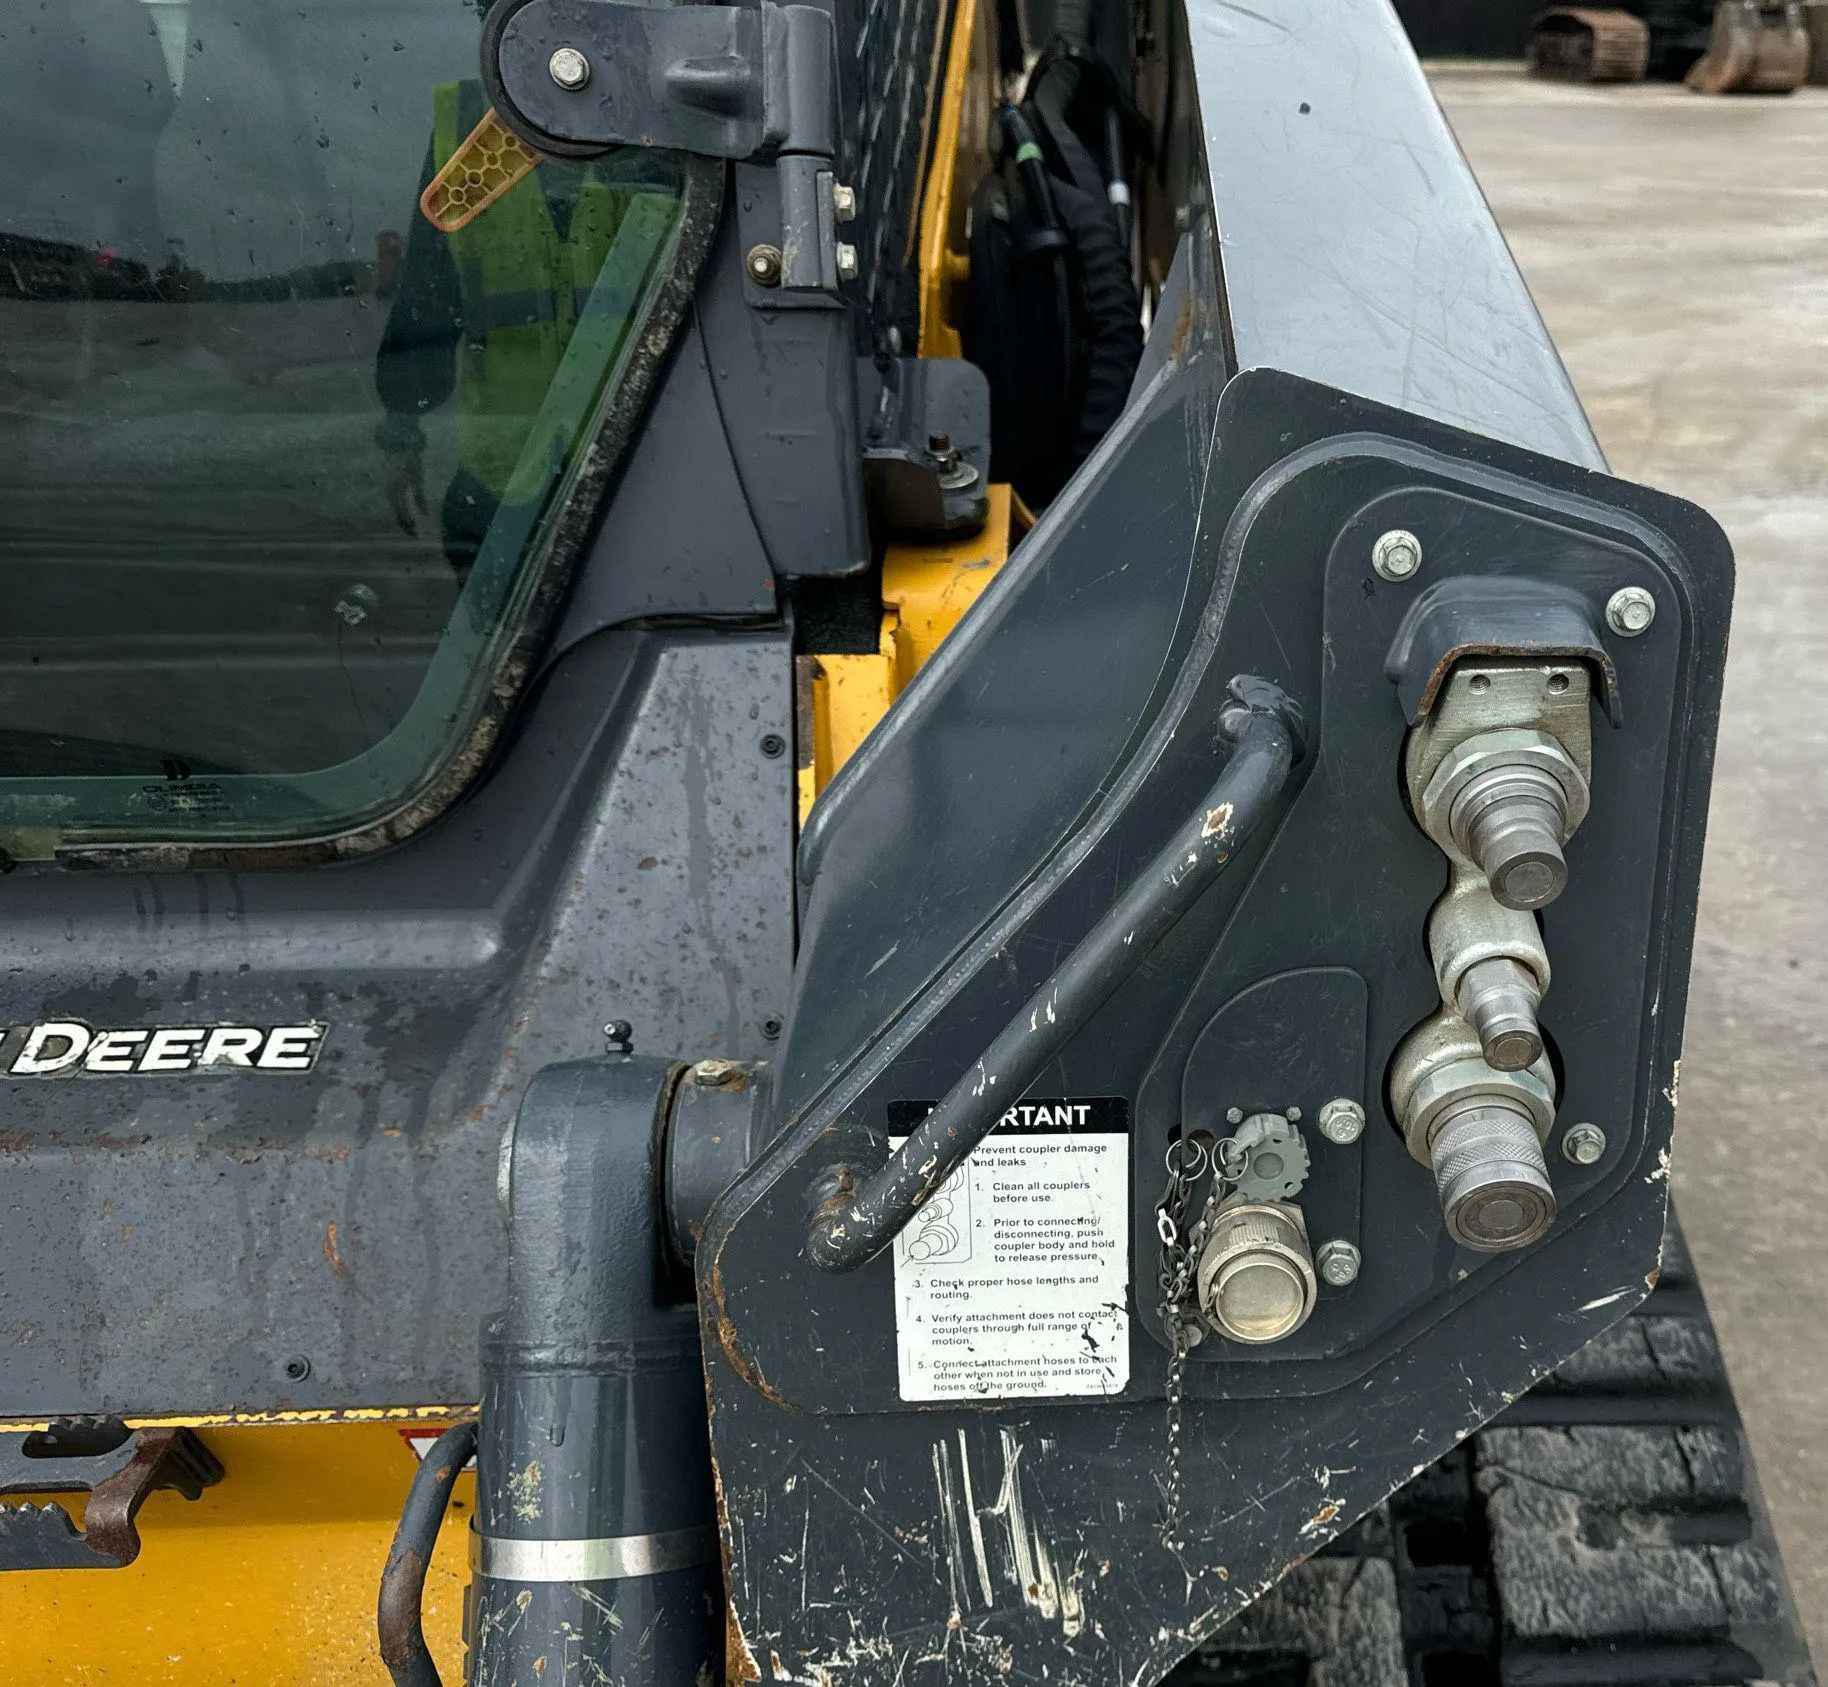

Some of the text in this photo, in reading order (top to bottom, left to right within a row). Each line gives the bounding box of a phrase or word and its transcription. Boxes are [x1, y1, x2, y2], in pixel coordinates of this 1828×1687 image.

[10, 1023, 318, 1073] DEERE
[972, 1144, 1106, 1155] Prevent coupler damage
[998, 1158, 1026, 1166] leaks
[1028, 1182, 1039, 1190] all
[1043, 1182, 1090, 1191] couplers
[994, 1194, 1027, 1202] before
[1078, 1228, 1103, 1238] push
[995, 1242, 1035, 1251] coupler
[1039, 1241, 1064, 1251] body
[931, 1279, 964, 1289] Check
[968, 1280, 1003, 1288] proper
[1037, 1276, 1075, 1286] lengths
[931, 1289, 972, 1300] routing.
[932, 1314, 962, 1324] Verify
[966, 1313, 1025, 1321] attachment
[1079, 1309, 1117, 1320] contact
[933, 1323, 978, 1335] couplers
[983, 1324, 1024, 1333] through
[1028, 1323, 1044, 1331] full
[1048, 1324, 1077, 1332] range
[934, 1360, 979, 1371] Connect
[980, 1358, 1040, 1367] attachment
[1043, 1355, 1075, 1364] hoses
[934, 1370, 961, 1379] other
[965, 1371, 993, 1380] when
[984, 1382, 1002, 1391] the
[1006, 1380, 1046, 1391] ground.
